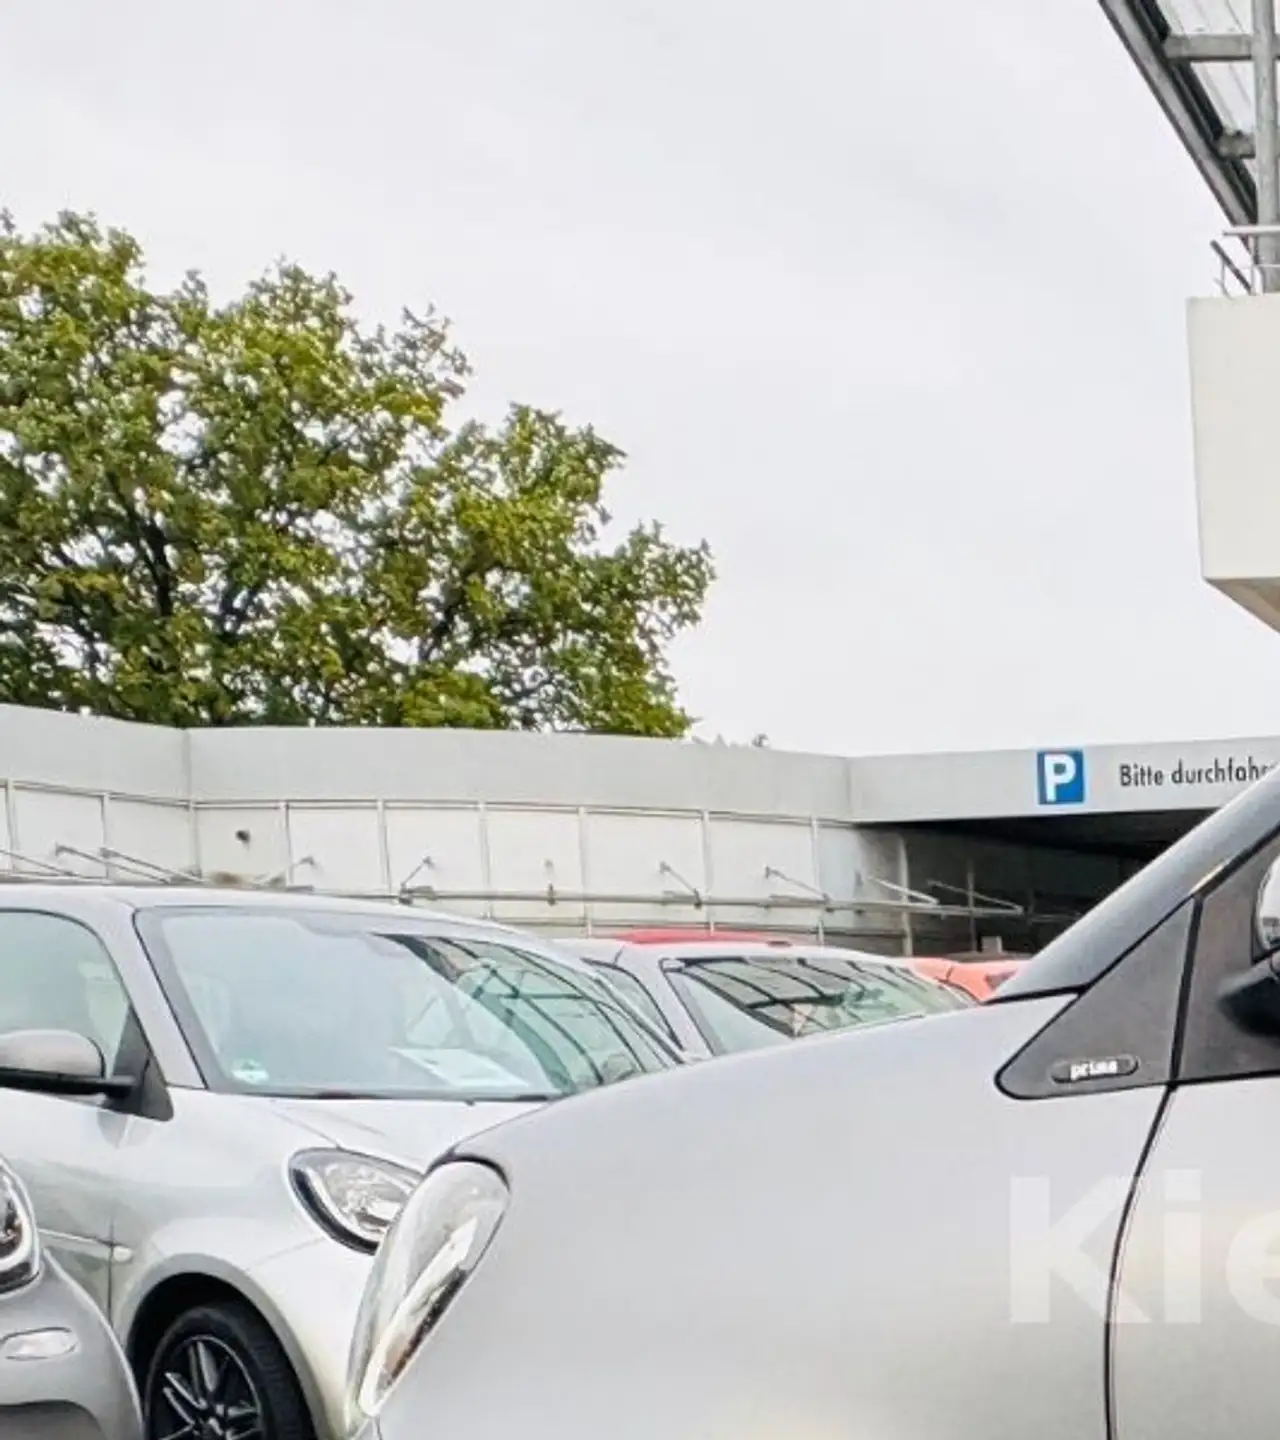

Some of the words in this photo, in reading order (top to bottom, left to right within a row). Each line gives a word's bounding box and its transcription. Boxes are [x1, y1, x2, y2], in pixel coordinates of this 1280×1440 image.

[1044, 754, 1077, 802] P
[1120, 762, 1164, 787] Bitte
[1171, 756, 1275, 784] durchfahr
